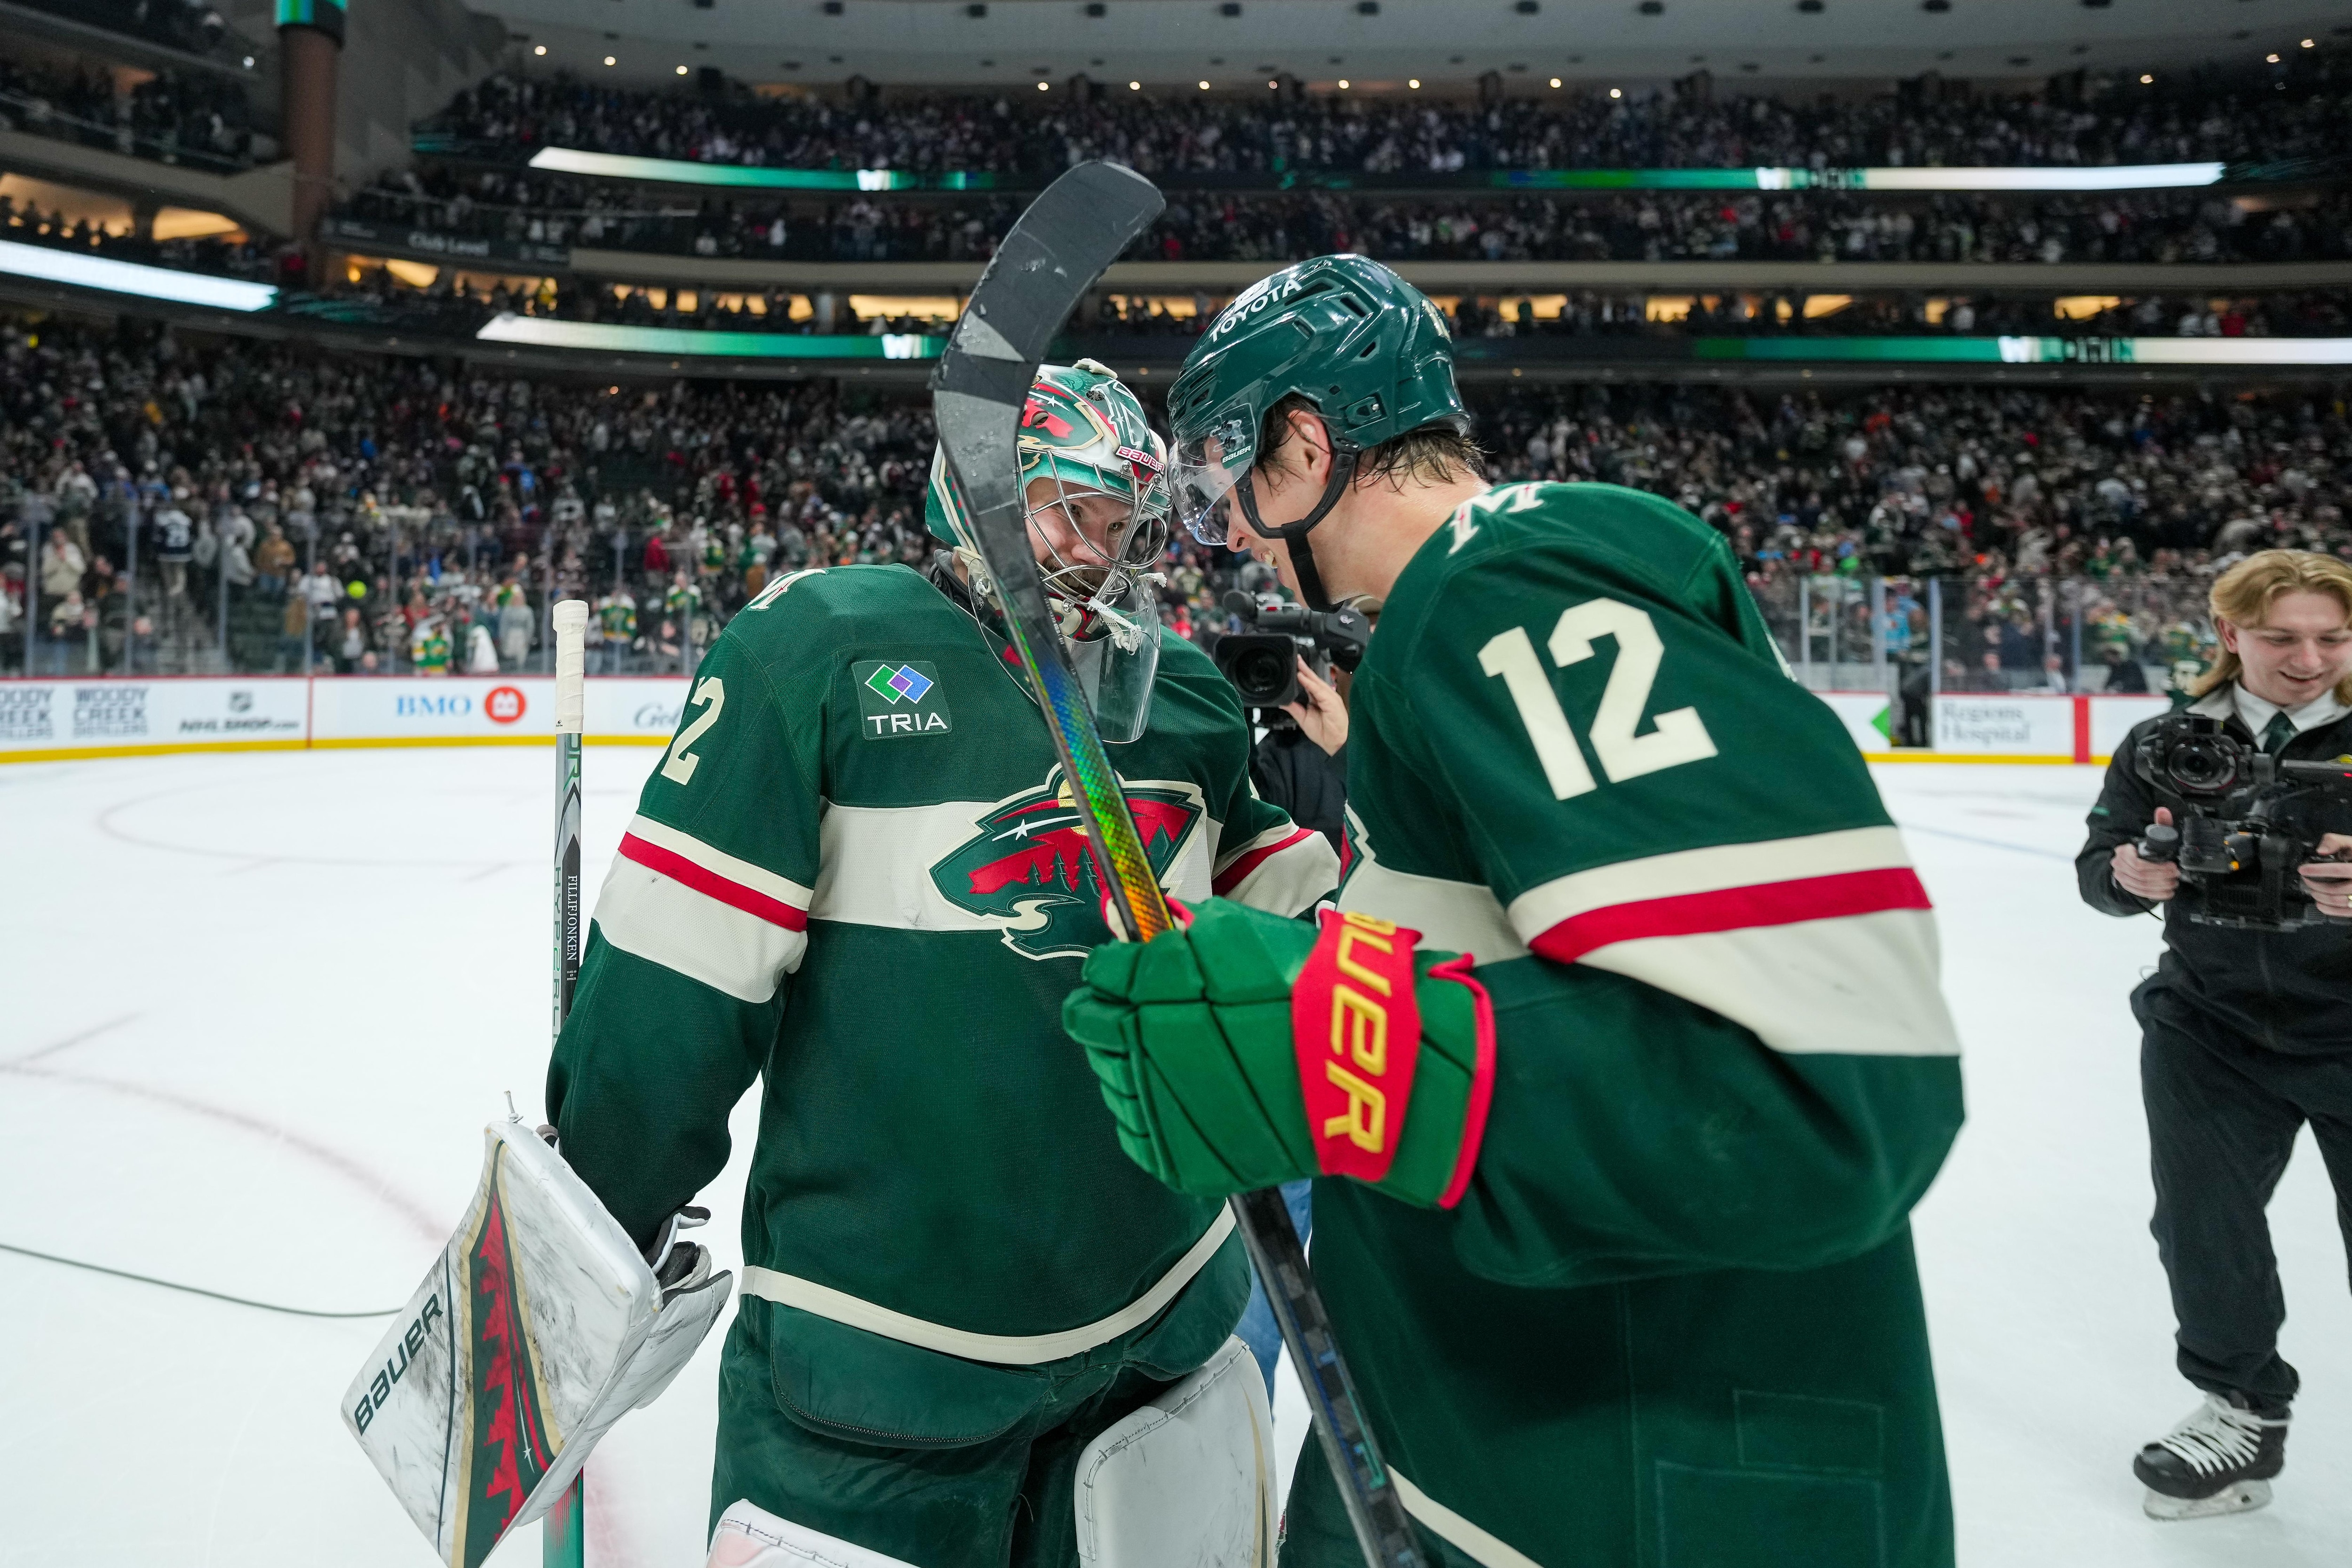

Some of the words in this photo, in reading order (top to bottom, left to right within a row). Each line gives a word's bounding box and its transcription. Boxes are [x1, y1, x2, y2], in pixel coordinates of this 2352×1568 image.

[1208, 278, 1303, 343] TOYOTA
[1115, 445, 1165, 475] BAUER
[1222, 445, 1251, 463] BAUER
[396, 695, 472, 717] BMO
[660, 676, 725, 786] 2
[867, 712, 948, 735] TRIA
[1477, 597, 1719, 801] 12
[567, 875, 578, 961] FILLIFJONKEN
[354, 1293, 443, 1437] BAUER
